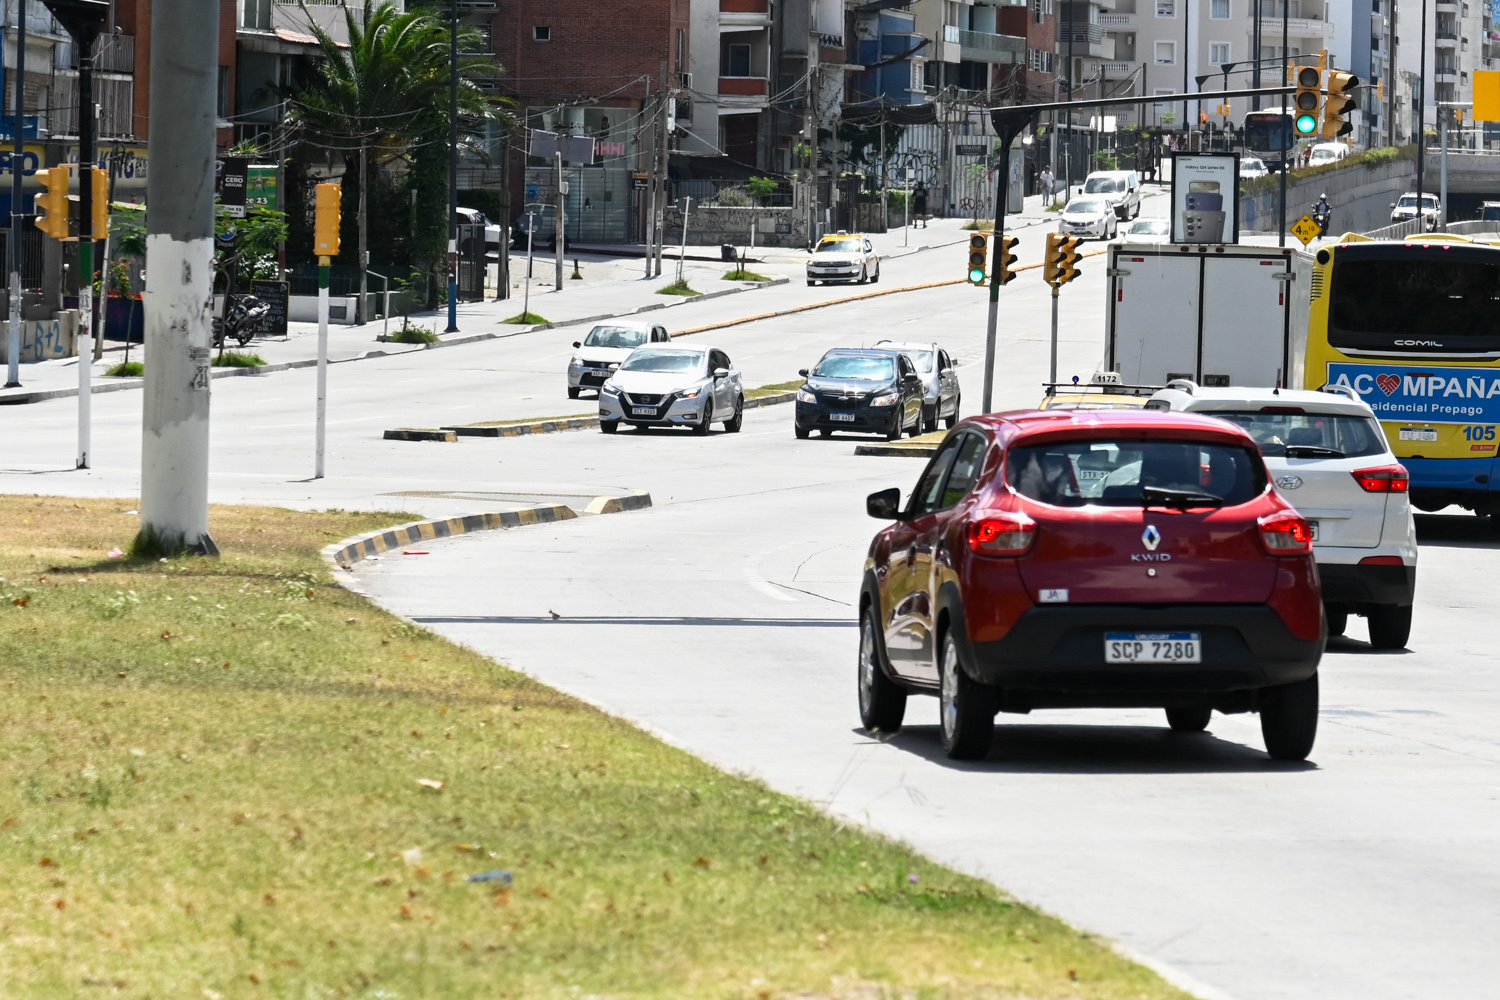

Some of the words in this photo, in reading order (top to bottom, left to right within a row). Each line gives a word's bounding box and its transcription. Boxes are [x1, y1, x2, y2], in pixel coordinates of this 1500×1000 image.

[1394, 339, 1443, 347] COMIL
[1097, 375, 1117, 383] 1172
[1431, 404, 1484, 416] Prepago
[1462, 426, 1496, 441] 105
[1130, 553, 1172, 562] KWID
[1111, 642, 1143, 659] SCP
[1152, 642, 1195, 659] 7280
